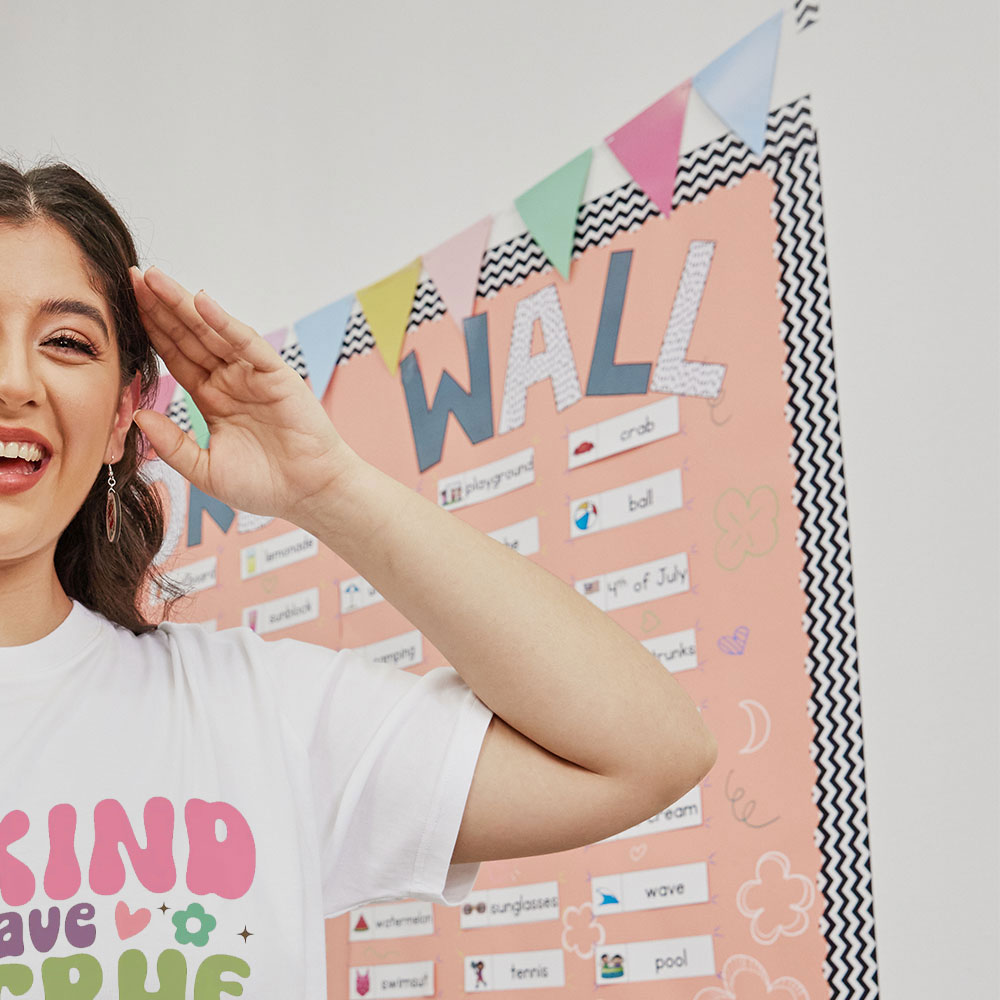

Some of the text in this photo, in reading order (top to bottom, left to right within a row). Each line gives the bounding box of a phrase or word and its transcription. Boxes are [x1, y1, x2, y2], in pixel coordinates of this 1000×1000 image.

[401, 240, 728, 473] WALL
[620, 417, 655, 441] crab
[465, 455, 535, 497] playground
[628, 489, 654, 511] ball
[265, 539, 313, 562] lemonade
[634, 572, 651, 592] of
[656, 565, 688, 587] July
[644, 881, 685, 898] wave
[490, 894, 559, 918] sunglasses
[375, 911, 433, 929] watermelon
[510, 963, 549, 981] tennis
[655, 949, 688, 973] pool
[381, 972, 429, 991] swimsuit
